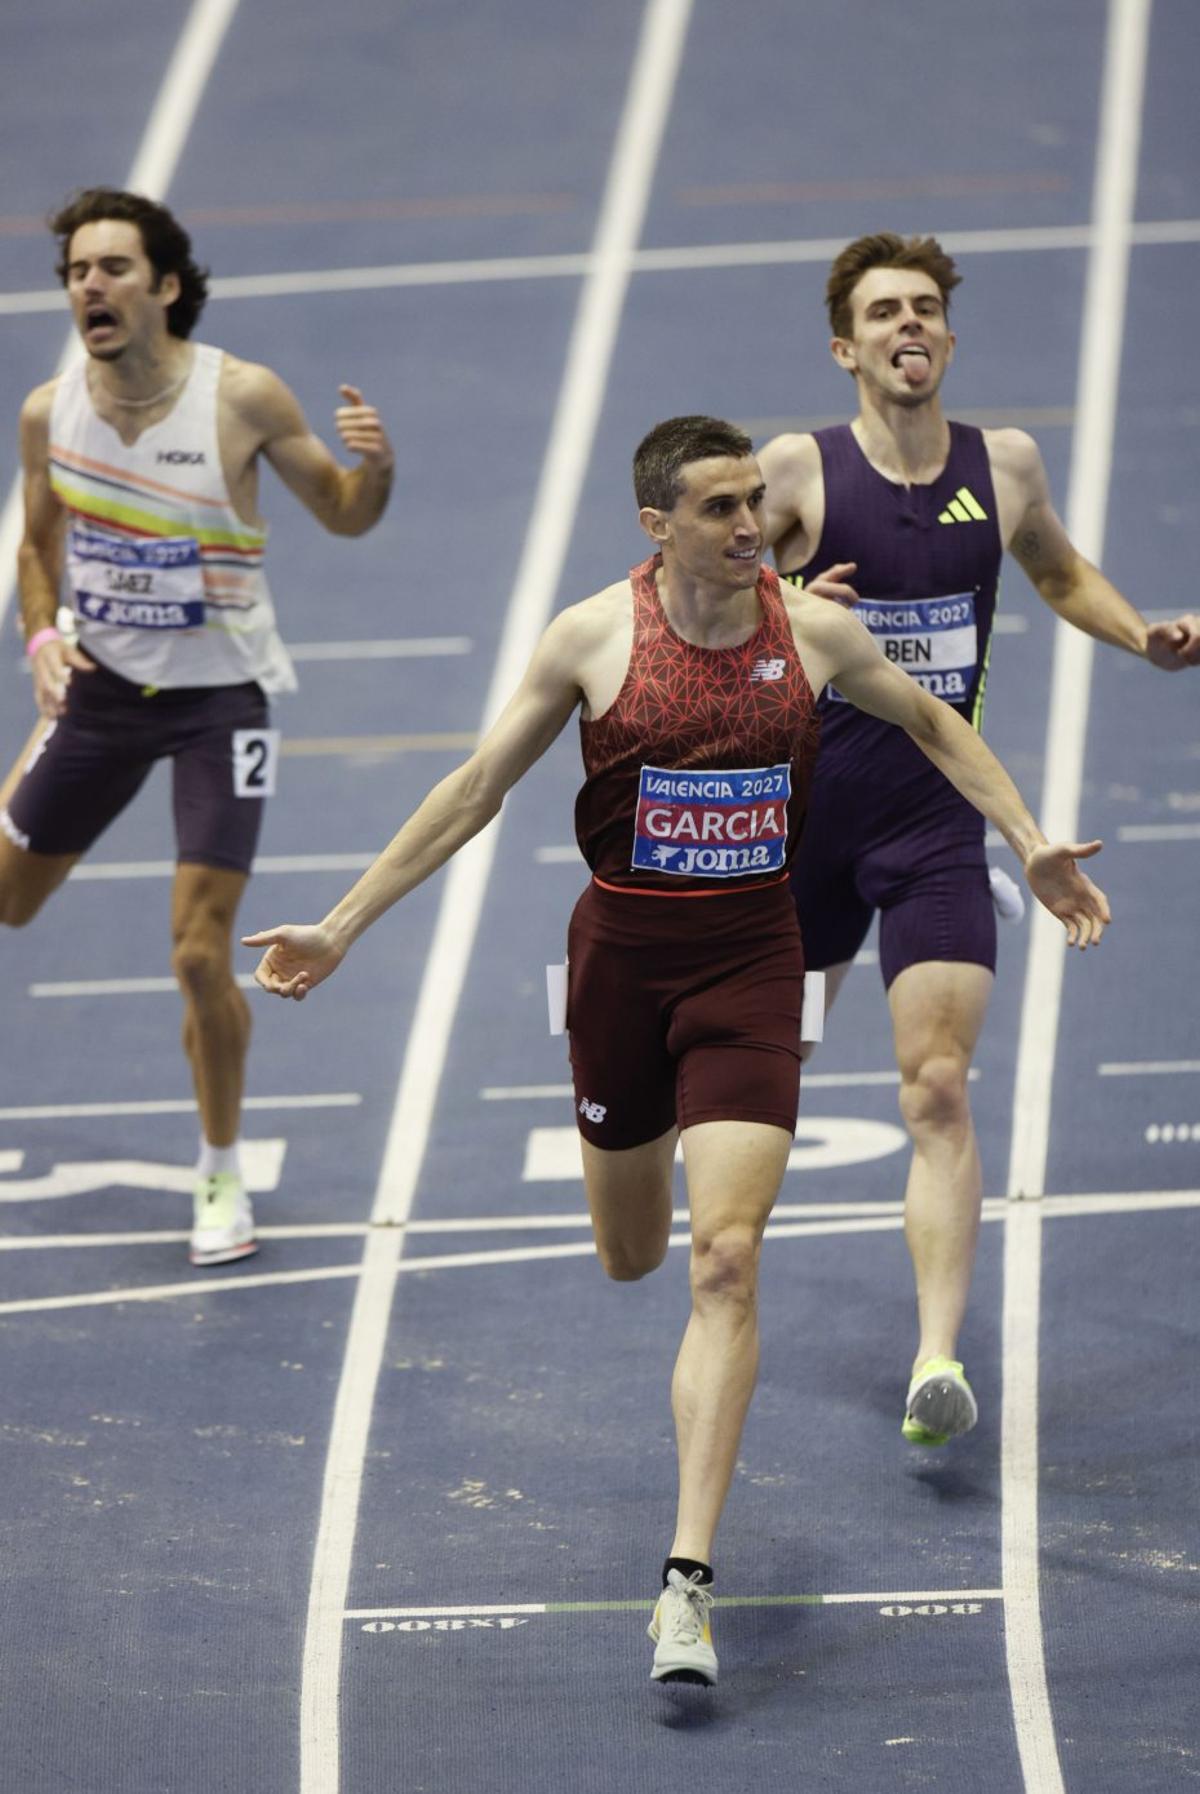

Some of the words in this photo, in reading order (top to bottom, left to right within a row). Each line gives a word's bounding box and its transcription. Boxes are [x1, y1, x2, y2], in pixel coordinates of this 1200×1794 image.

[156, 451, 206, 464] HOKA
[929, 602, 970, 625] 2027
[885, 638, 931, 663] BEN
[245, 739, 268, 788] 2
[741, 775, 783, 797] 2027
[645, 807, 780, 841] GARCIA
[879, 1603, 983, 1617] 800
